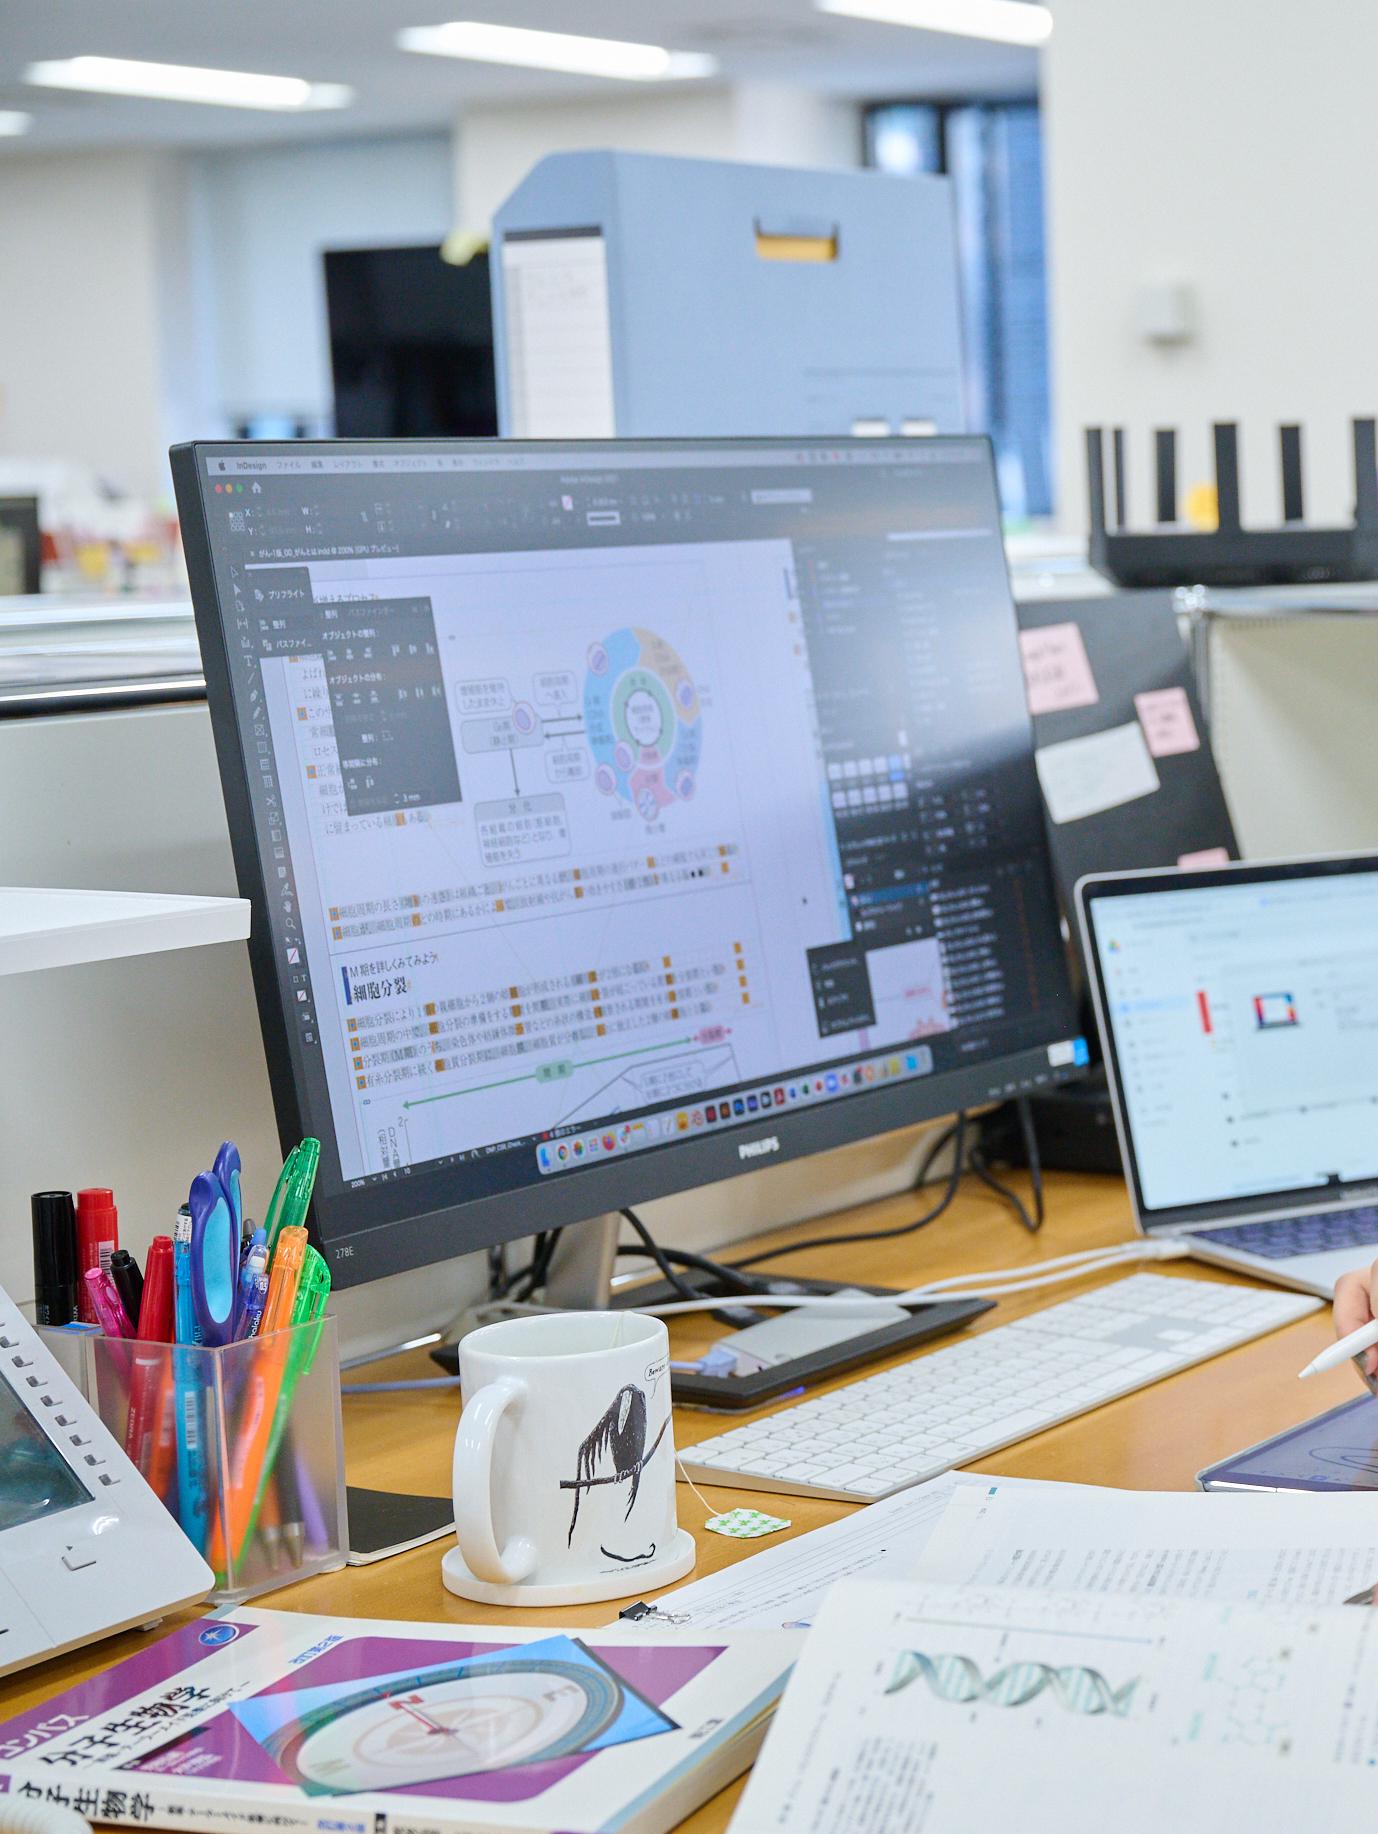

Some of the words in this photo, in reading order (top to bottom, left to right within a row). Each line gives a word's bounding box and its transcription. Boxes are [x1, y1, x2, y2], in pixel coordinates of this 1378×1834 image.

[235, 460, 268, 472] InDesign
[266, 587, 306, 601] プリフライト
[350, 975, 409, 1004] 細胞分裂
[738, 1135, 780, 1160] PHILIPS
[335, 1246, 355, 1260] 278E
[39, 1686, 210, 1767] 分子生物学
[17, 1781, 155, 1821] 分子生物学
